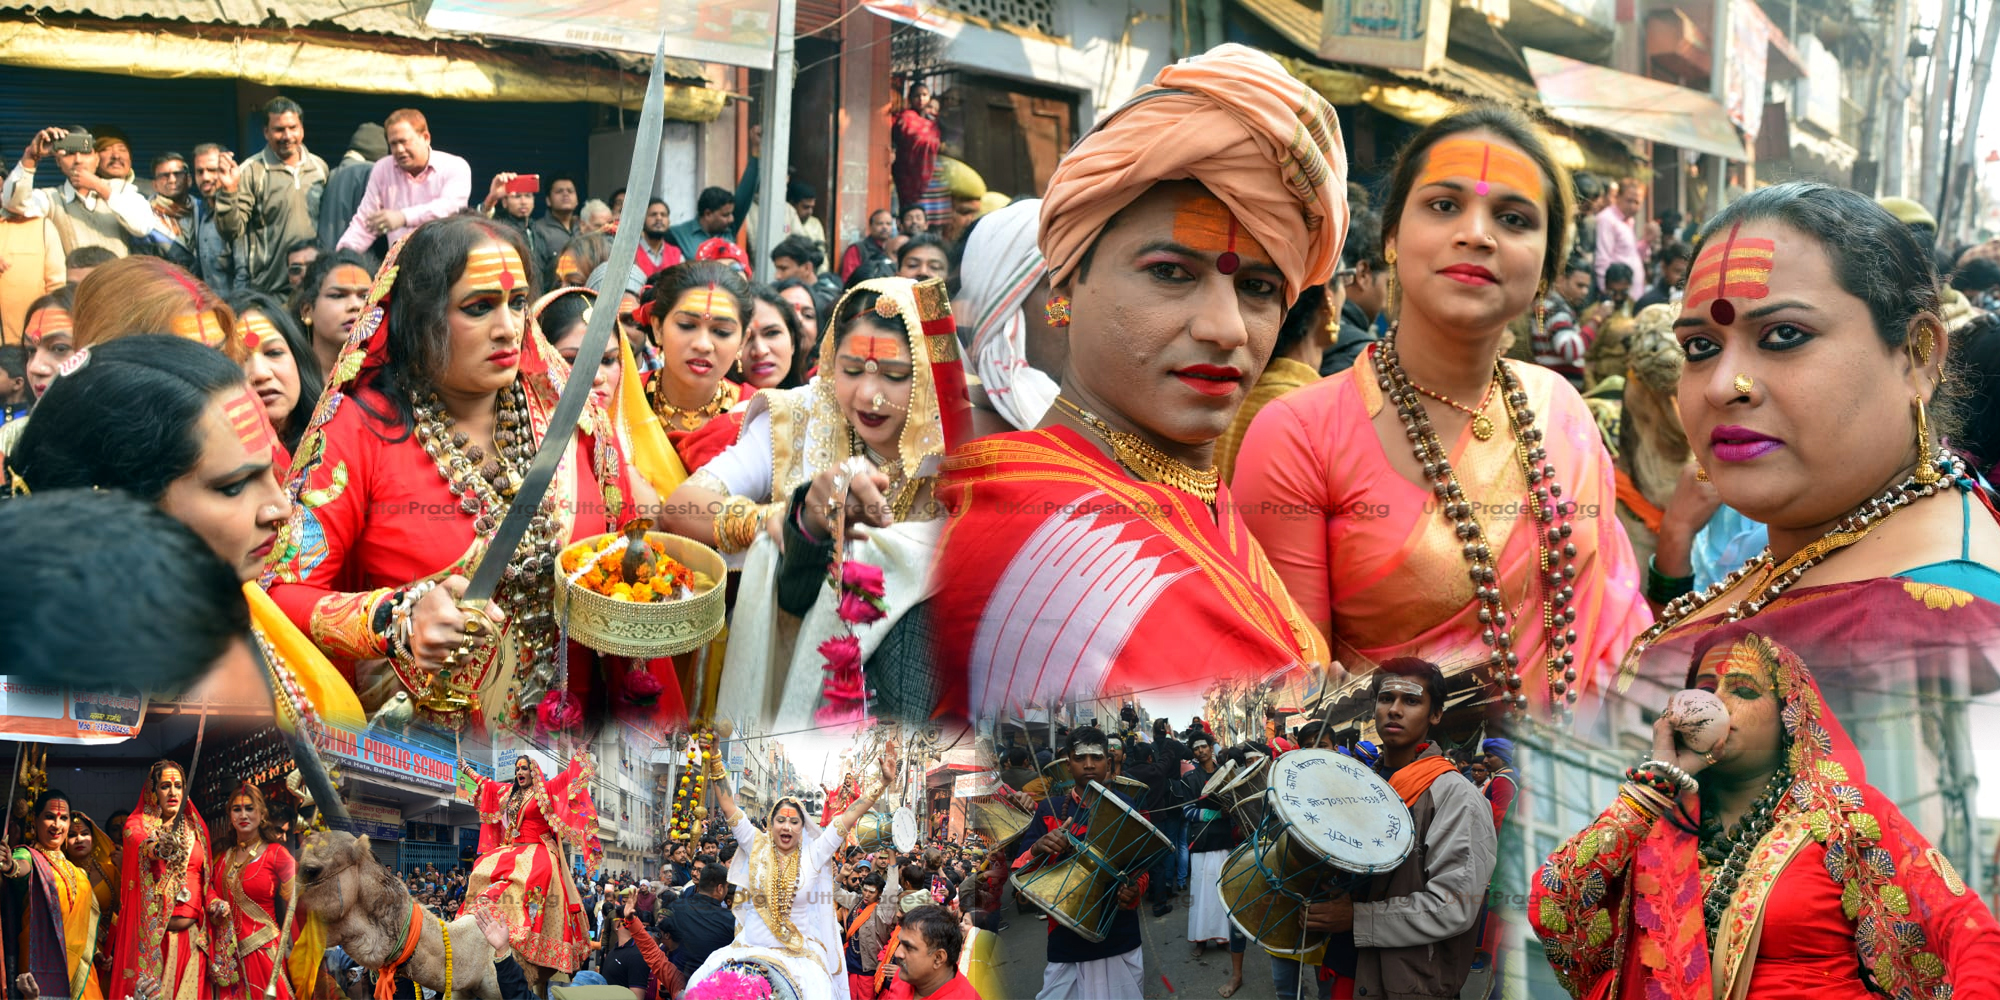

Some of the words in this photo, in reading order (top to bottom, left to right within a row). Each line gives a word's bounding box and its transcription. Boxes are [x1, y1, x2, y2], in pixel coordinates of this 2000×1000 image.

[501, 748, 516, 757] AJAY
[364, 737, 411, 772] PUBLIC
[413, 753, 455, 783] SCHOOL
[498, 753, 518, 763] MEDICAL
[498, 759, 517, 768] AGENCIE
[341, 757, 352, 766] Ka
[353, 761, 372, 772] Hata,
[373, 765, 415, 782] Bahadurganj,
[415, 777, 442, 788] Allahabad
